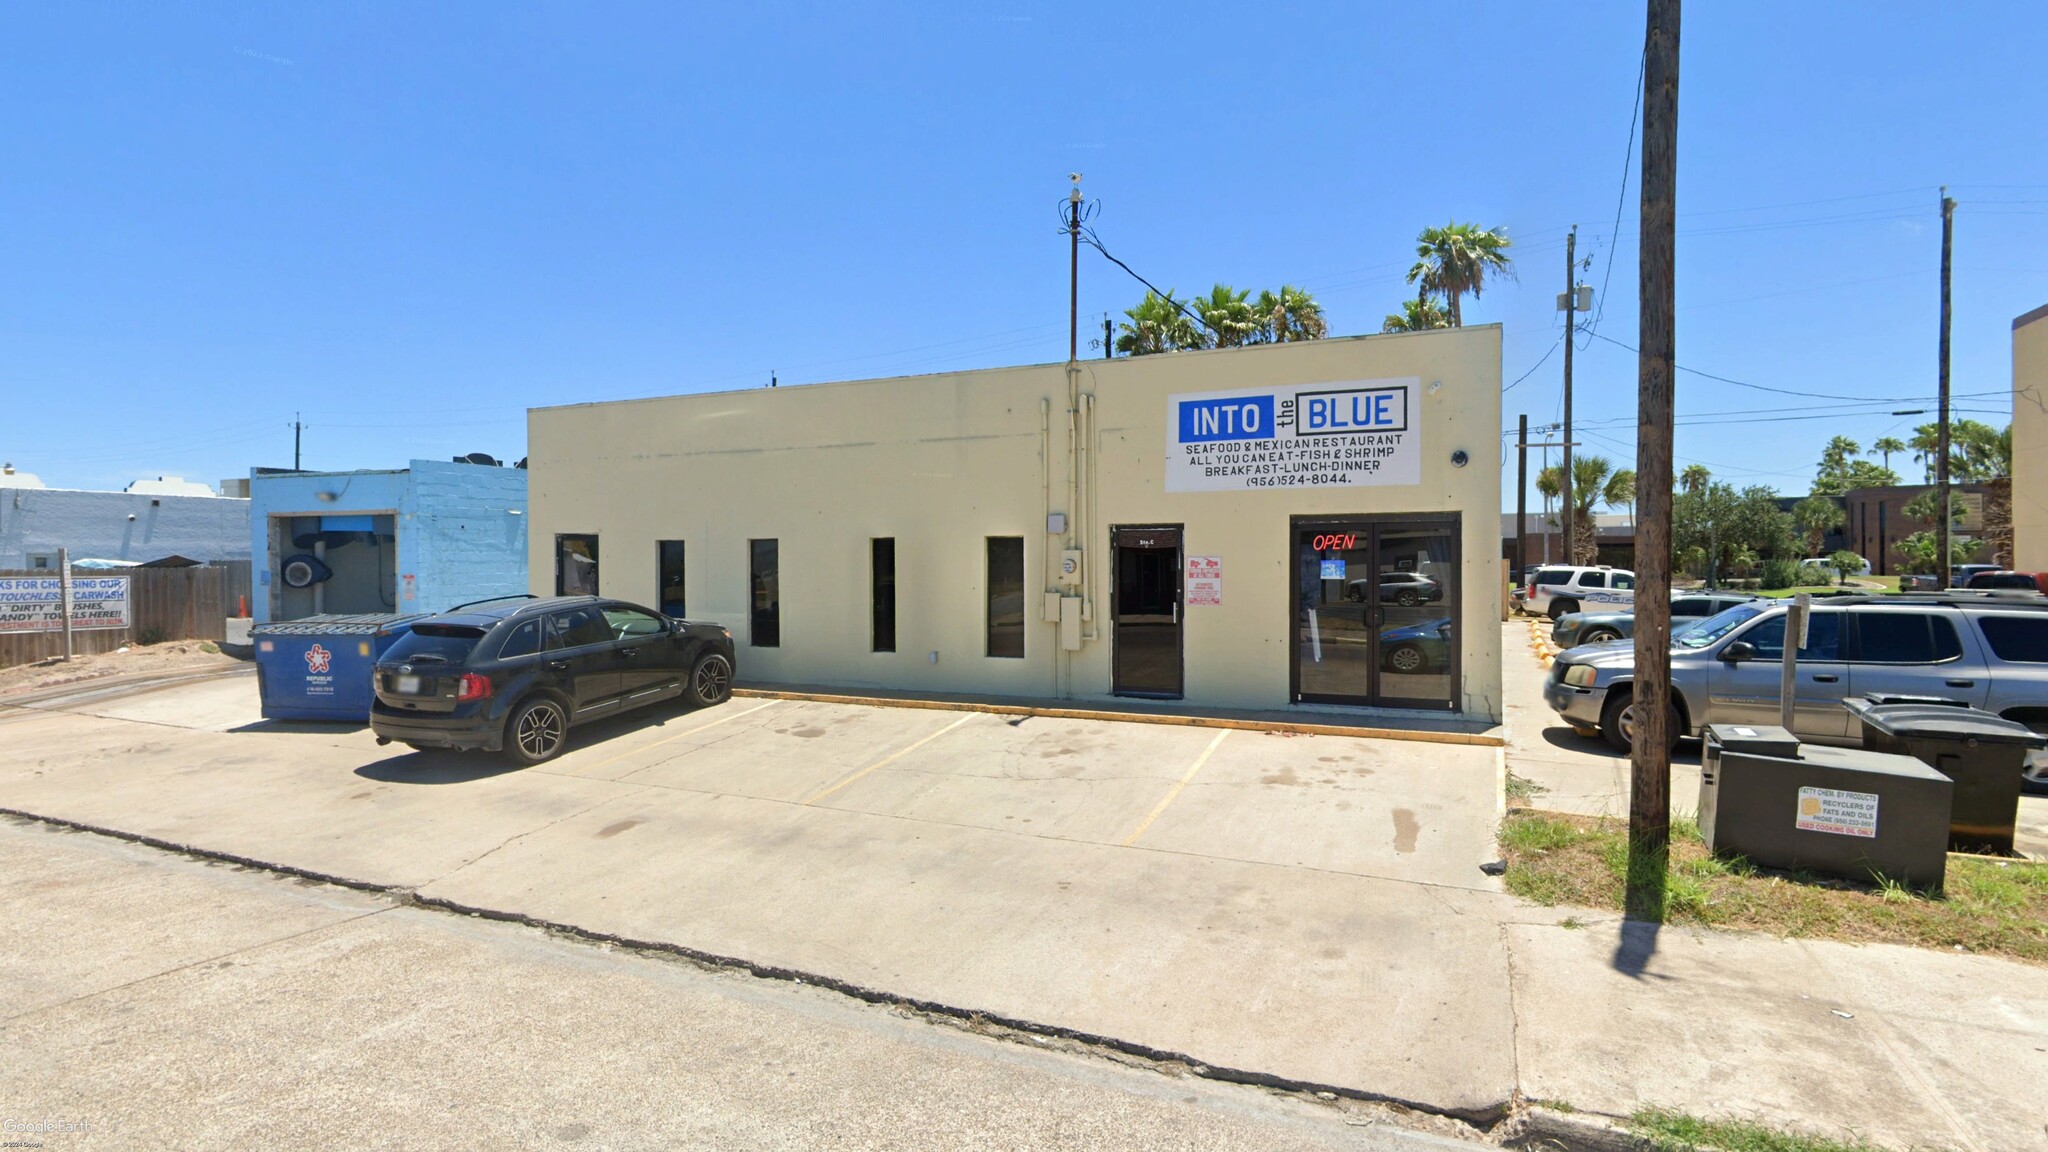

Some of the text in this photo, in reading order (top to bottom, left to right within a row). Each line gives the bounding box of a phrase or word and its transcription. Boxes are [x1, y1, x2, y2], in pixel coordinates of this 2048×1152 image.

[1276, 399, 1294, 428] the
[1309, 394, 1394, 429] BLUE
[1193, 404, 1260, 435] INTO
[1186, 434, 1403, 455] SEAFOOD & MEXICAN RESTAURANT
[1190, 455, 1212, 466] ALL
[1216, 454, 1240, 465] YOU
[1242, 453, 1266, 464] CAN
[1333, 448, 1341, 459] &
[1344, 446, 1395, 459] SHRIMP
[1312, 533, 1356, 551] OPEN
[15, 580, 38, 590] FOR
[40, 579, 97, 590] CHOSING
[99, 579, 121, 588] OUR
[0, 590, 124, 601] TOUCHLES CARWASH
[42, 611, 86, 620] TOELS
[88, 610, 122, 619] HERE!!
[1846, 792, 1877, 802] PRODUCTS
[1822, 799, 1864, 810] RECYCLERS
[1813, 815, 1832, 823] PHONE
[1858, 812, 1874, 820] OILS
[1816, 823, 1844, 833] COOKING
[1845, 827, 1856, 835] OIL
[1858, 828, 1873, 836] ONLY
